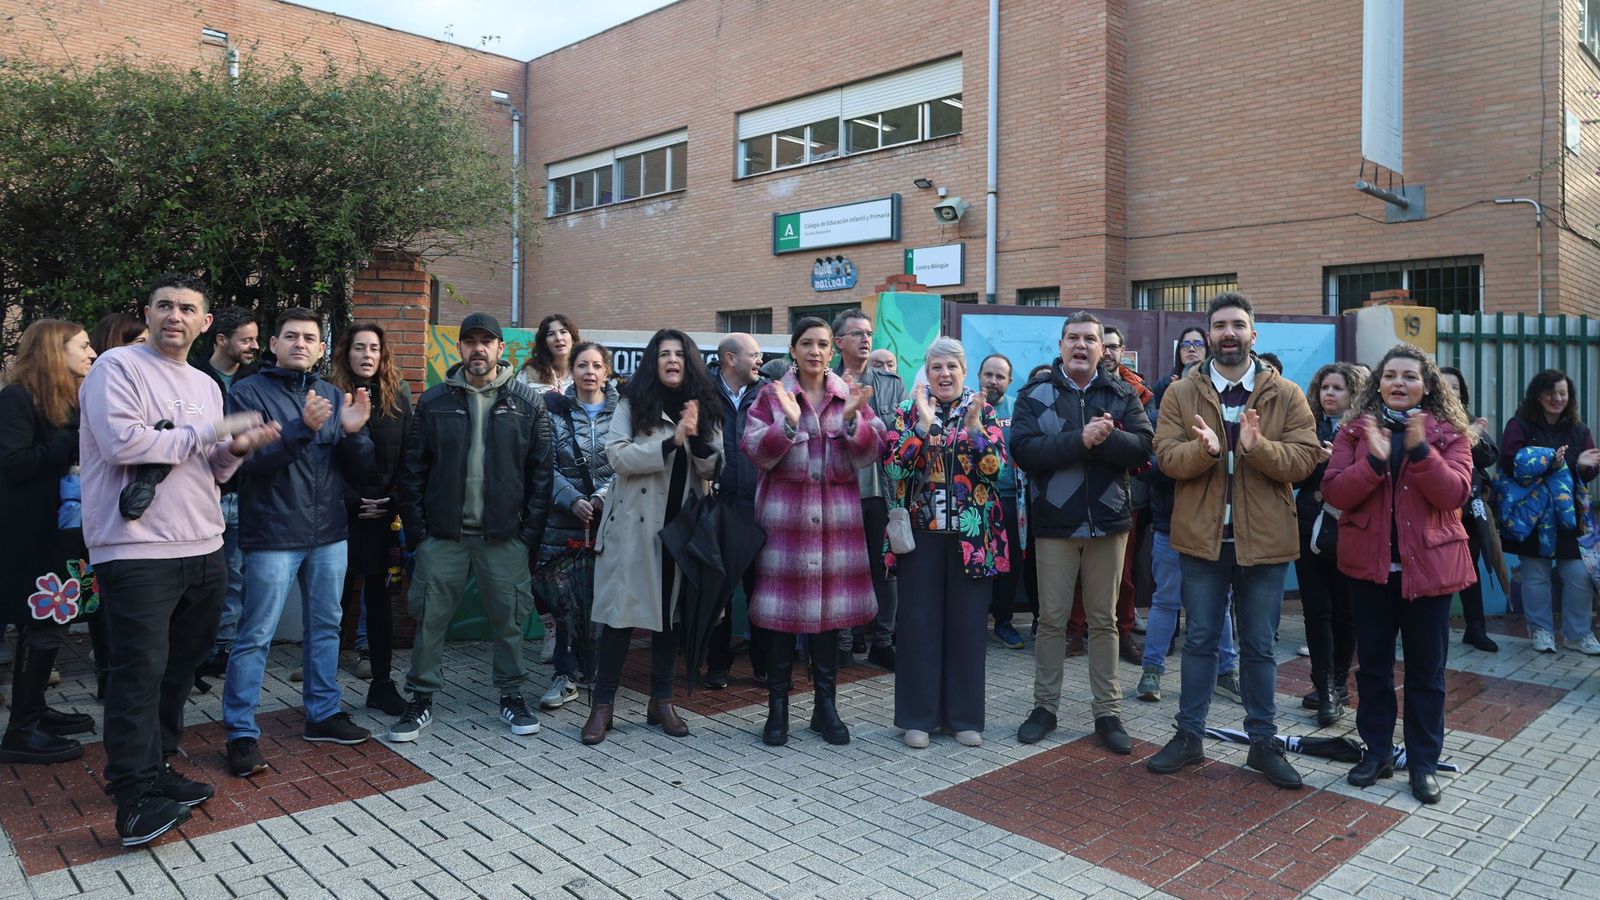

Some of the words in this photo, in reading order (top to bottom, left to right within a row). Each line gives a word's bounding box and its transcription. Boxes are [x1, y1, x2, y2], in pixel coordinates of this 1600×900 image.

[784, 223, 794, 236] A
[804, 222, 820, 231] Colegio
[826, 217, 849, 227] Educación
[849, 214, 866, 224] Infantil
[870, 212, 890, 221] Primaria
[931, 262, 949, 270] Bilingüe
[1403, 315, 1421, 337] 19
